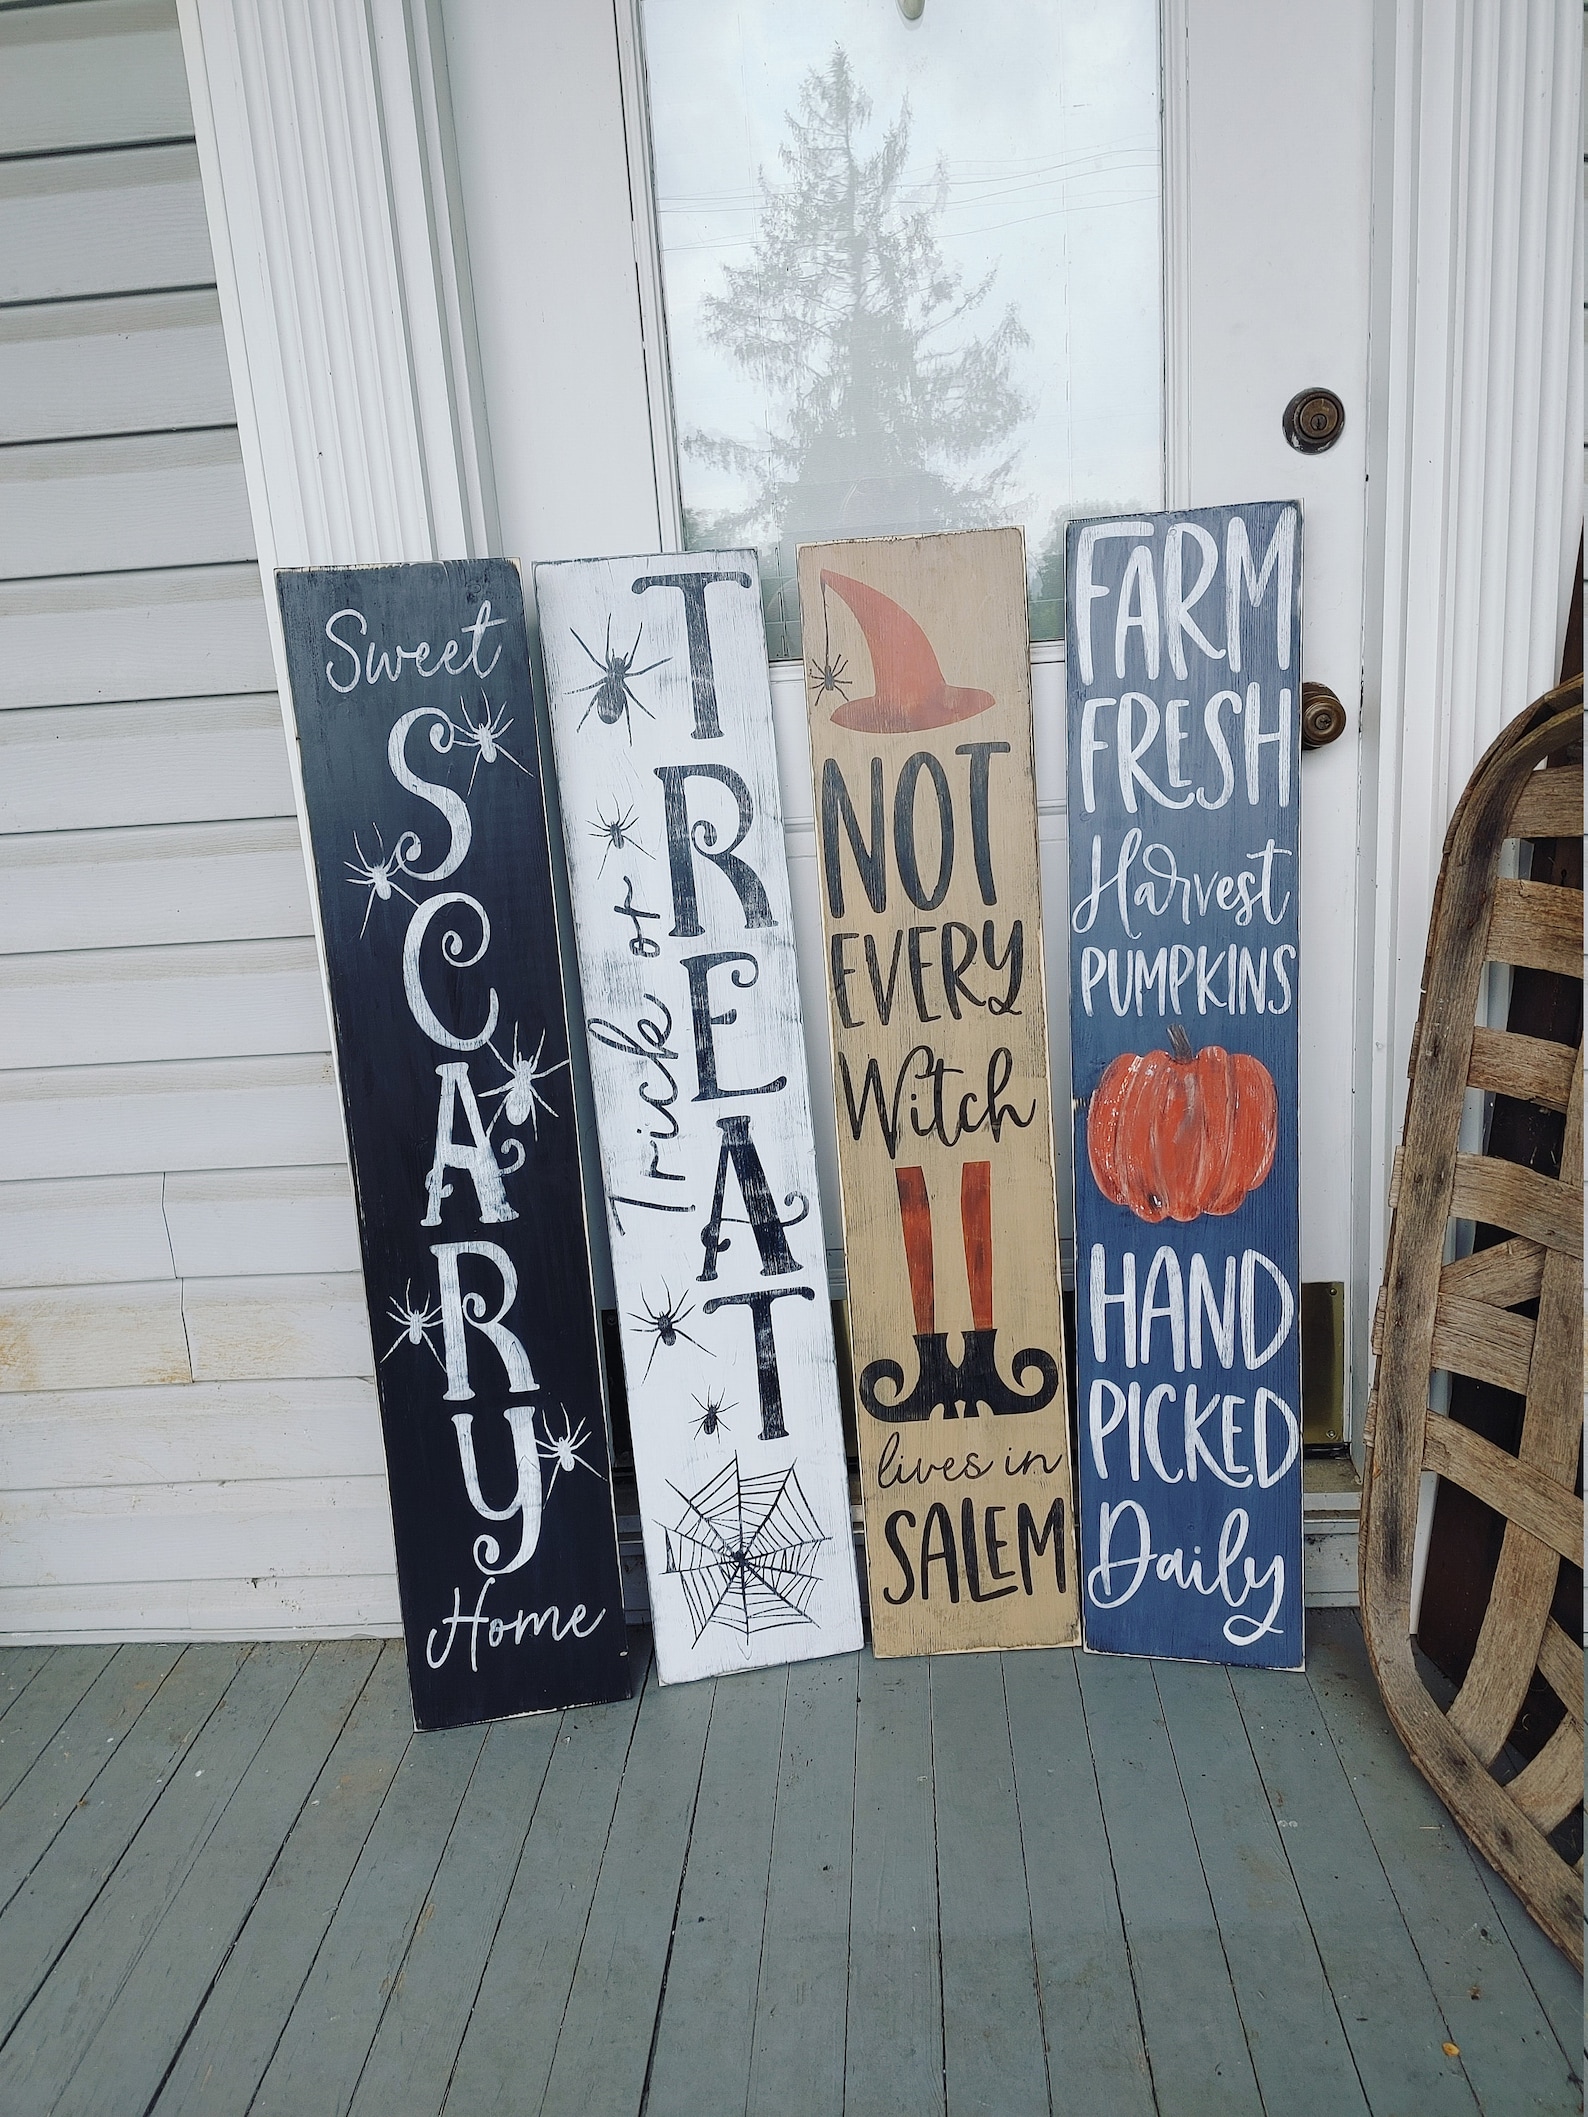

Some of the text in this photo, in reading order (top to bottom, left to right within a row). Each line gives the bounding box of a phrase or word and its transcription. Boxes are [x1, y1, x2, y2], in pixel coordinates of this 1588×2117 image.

[325, 600, 508, 694] Sweet
[1076, 507, 1298, 686] FARM
[1082, 682, 1291, 814] FRESH
[822, 741, 1010, 918] NOT
[1073, 828, 1292, 939] Harvest
[631, 571, 815, 1440] TREAT
[830, 919, 1023, 1029] EVERY
[1081, 943, 1297, 1017] PUMPKINS
[587, 876, 695, 1236] Trick or
[837, 1045, 1035, 1159] Witch
[387, 707, 543, 1575] SCARY
[1090, 1244, 1294, 1372] HAND
[877, 1432, 1063, 1489] lives in
[1090, 1379, 1299, 1489] PICKED
[884, 1497, 1066, 1604] SALEM
[1087, 1500, 1284, 1646] Daily
[426, 1577, 606, 1672] Home
